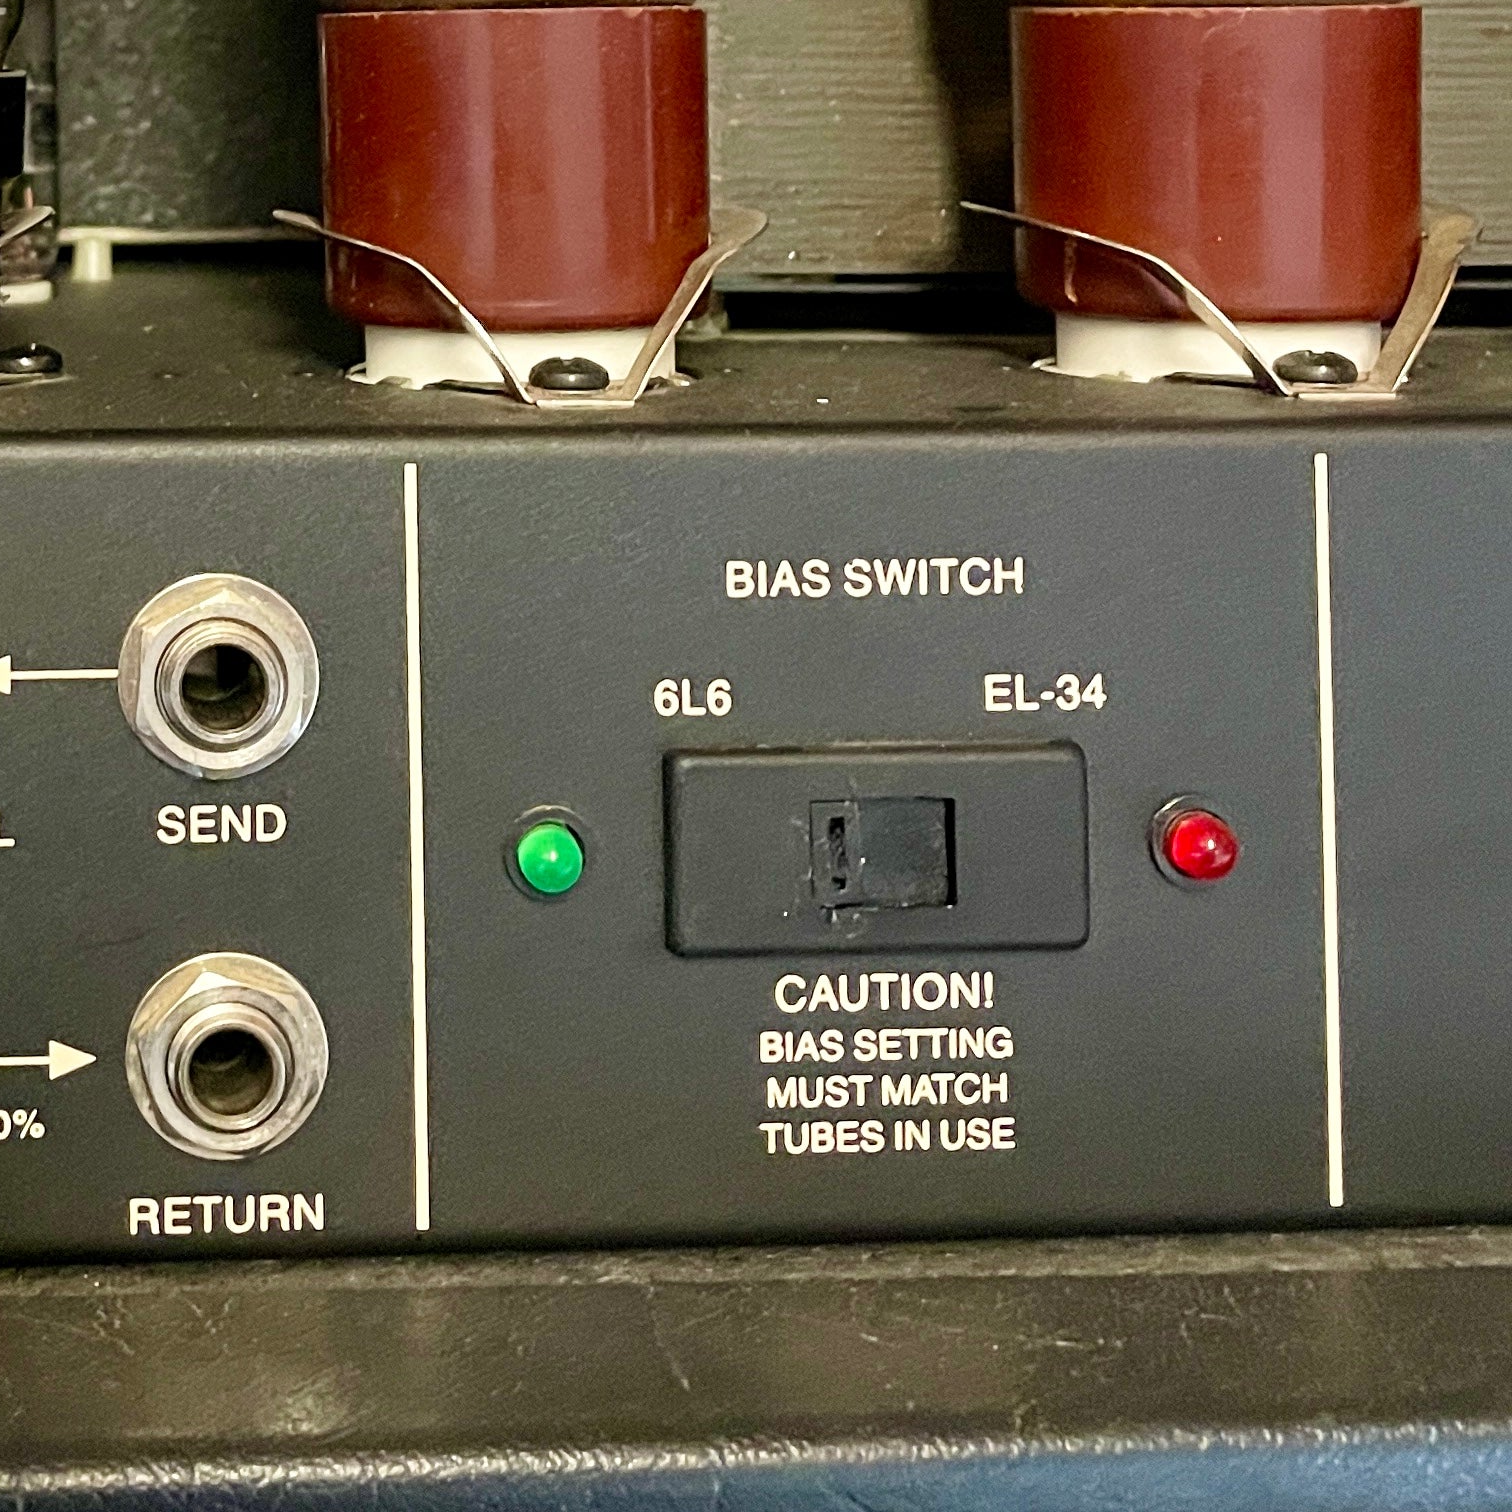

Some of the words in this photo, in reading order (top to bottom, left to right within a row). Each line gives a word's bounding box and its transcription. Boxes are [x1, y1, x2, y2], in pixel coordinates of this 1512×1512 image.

[726, 559, 831, 598] BIAS
[844, 557, 1023, 597] SWITCH
[654, 679, 731, 716] 6L6
[985, 674, 1107, 711] EL-34
[157, 804, 286, 844] SEND
[775, 972, 993, 1013] CAUTION!
[760, 1029, 844, 1063] BIAS
[853, 1027, 1013, 1061] SETTING
[767, 1075, 873, 1108] MUST
[881, 1073, 1007, 1106] MATCH
[758, 1120, 885, 1154] TUBES
[895, 1120, 930, 1150] IN
[940, 1117, 1015, 1151] USE
[130, 1193, 324, 1235] RETURN
